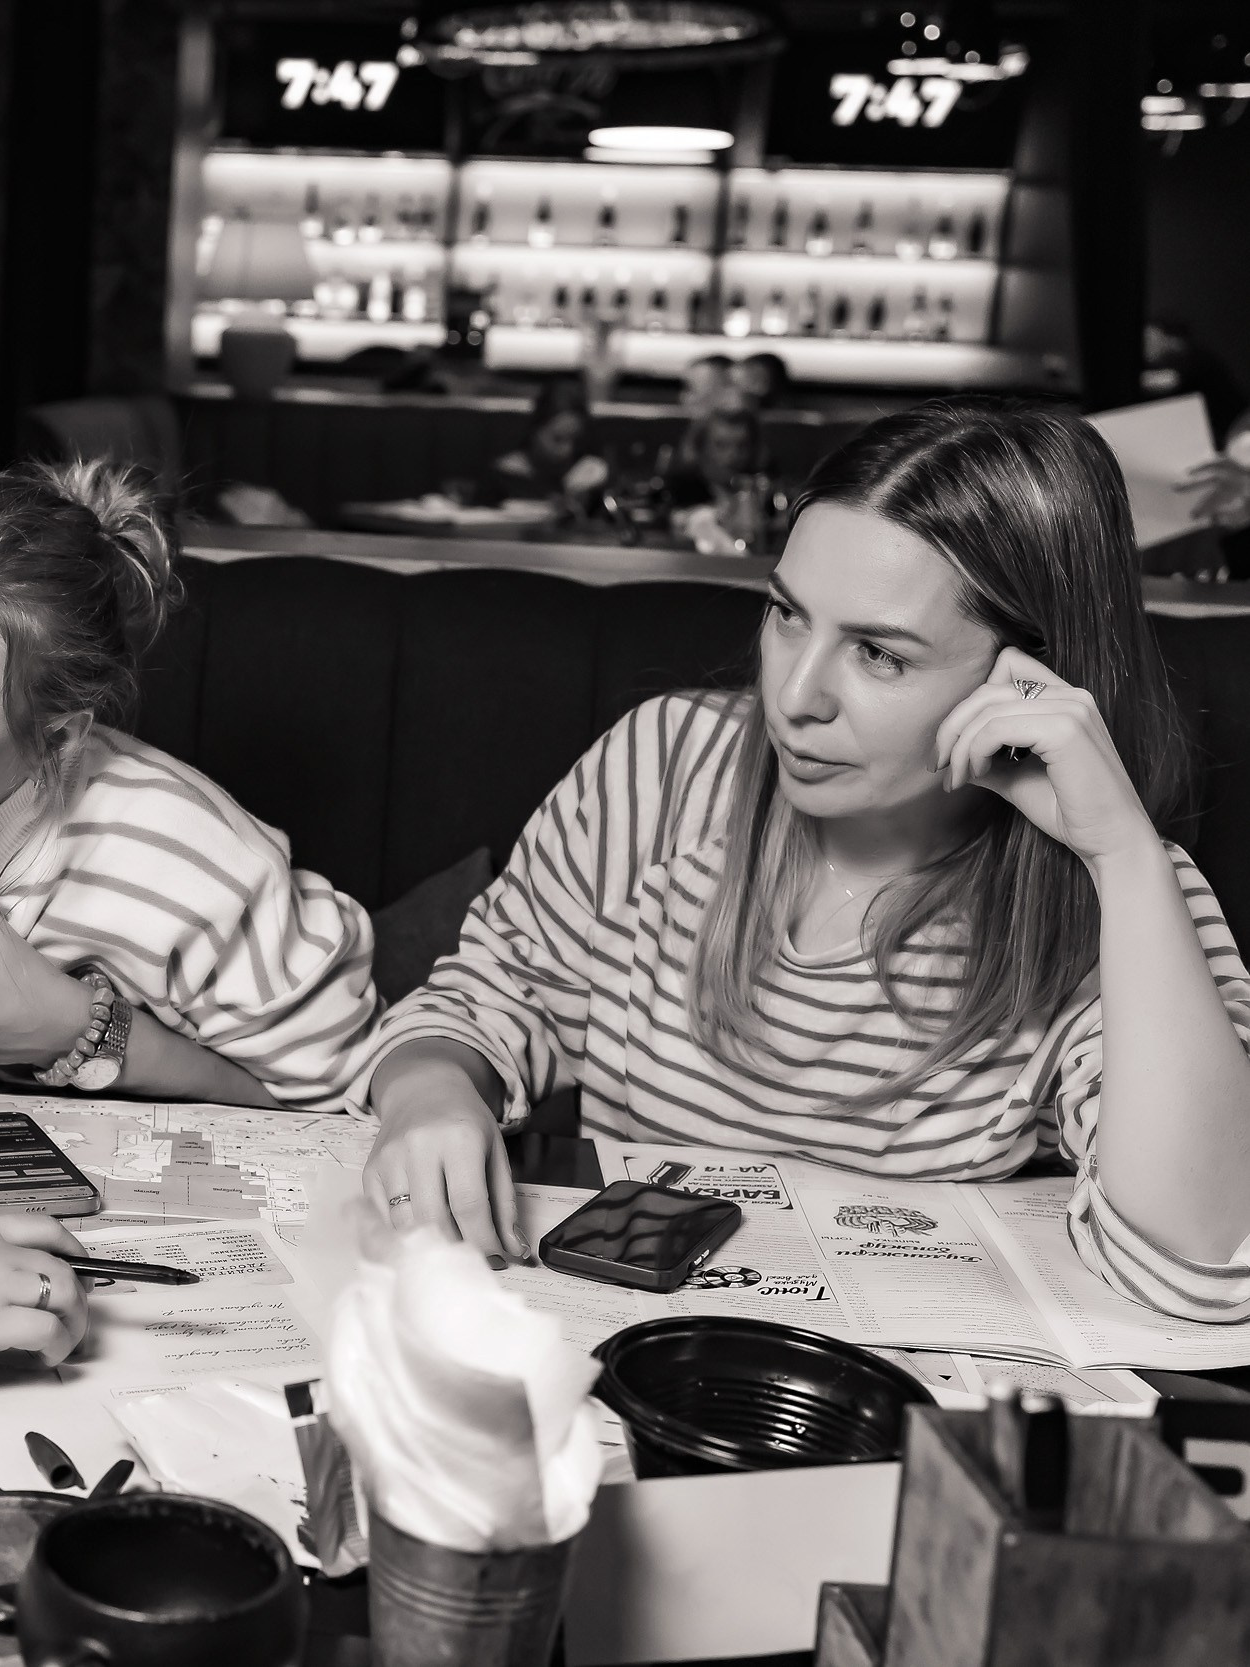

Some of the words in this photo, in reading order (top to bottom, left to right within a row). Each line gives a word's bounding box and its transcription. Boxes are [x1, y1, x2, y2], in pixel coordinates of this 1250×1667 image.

[276, 57, 399, 112] 7:47
[829, 72, 963, 128] 7:47
[834, 1249, 983, 1263] Буланжери
[183, 1263, 266, 1273] УДОСТОВЕ
[773, 1279, 818, 1287] Музыка
